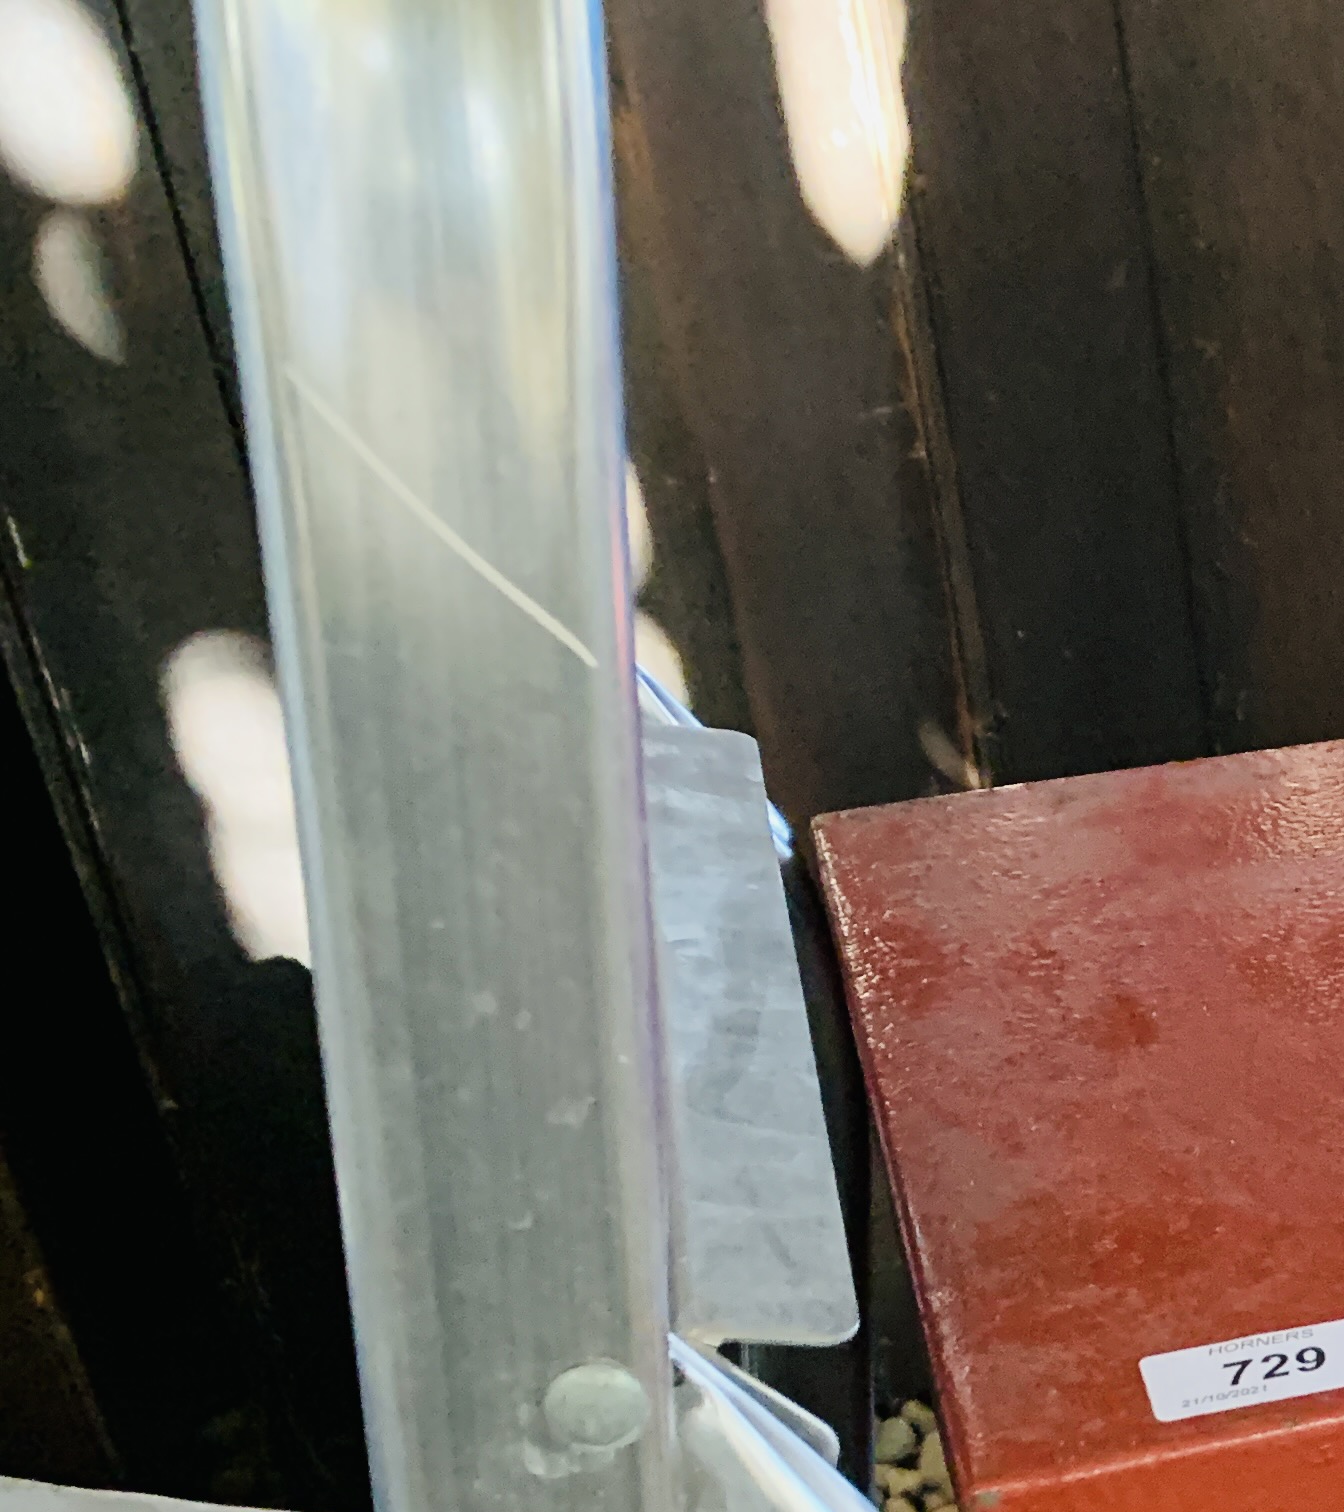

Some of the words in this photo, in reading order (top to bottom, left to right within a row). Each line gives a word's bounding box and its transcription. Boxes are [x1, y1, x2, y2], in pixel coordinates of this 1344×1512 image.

[1208, 1328, 1314, 1356] HORNERS
[1222, 1346, 1326, 1387] 729
[1181, 1384, 1269, 1408] 21/10/2021
